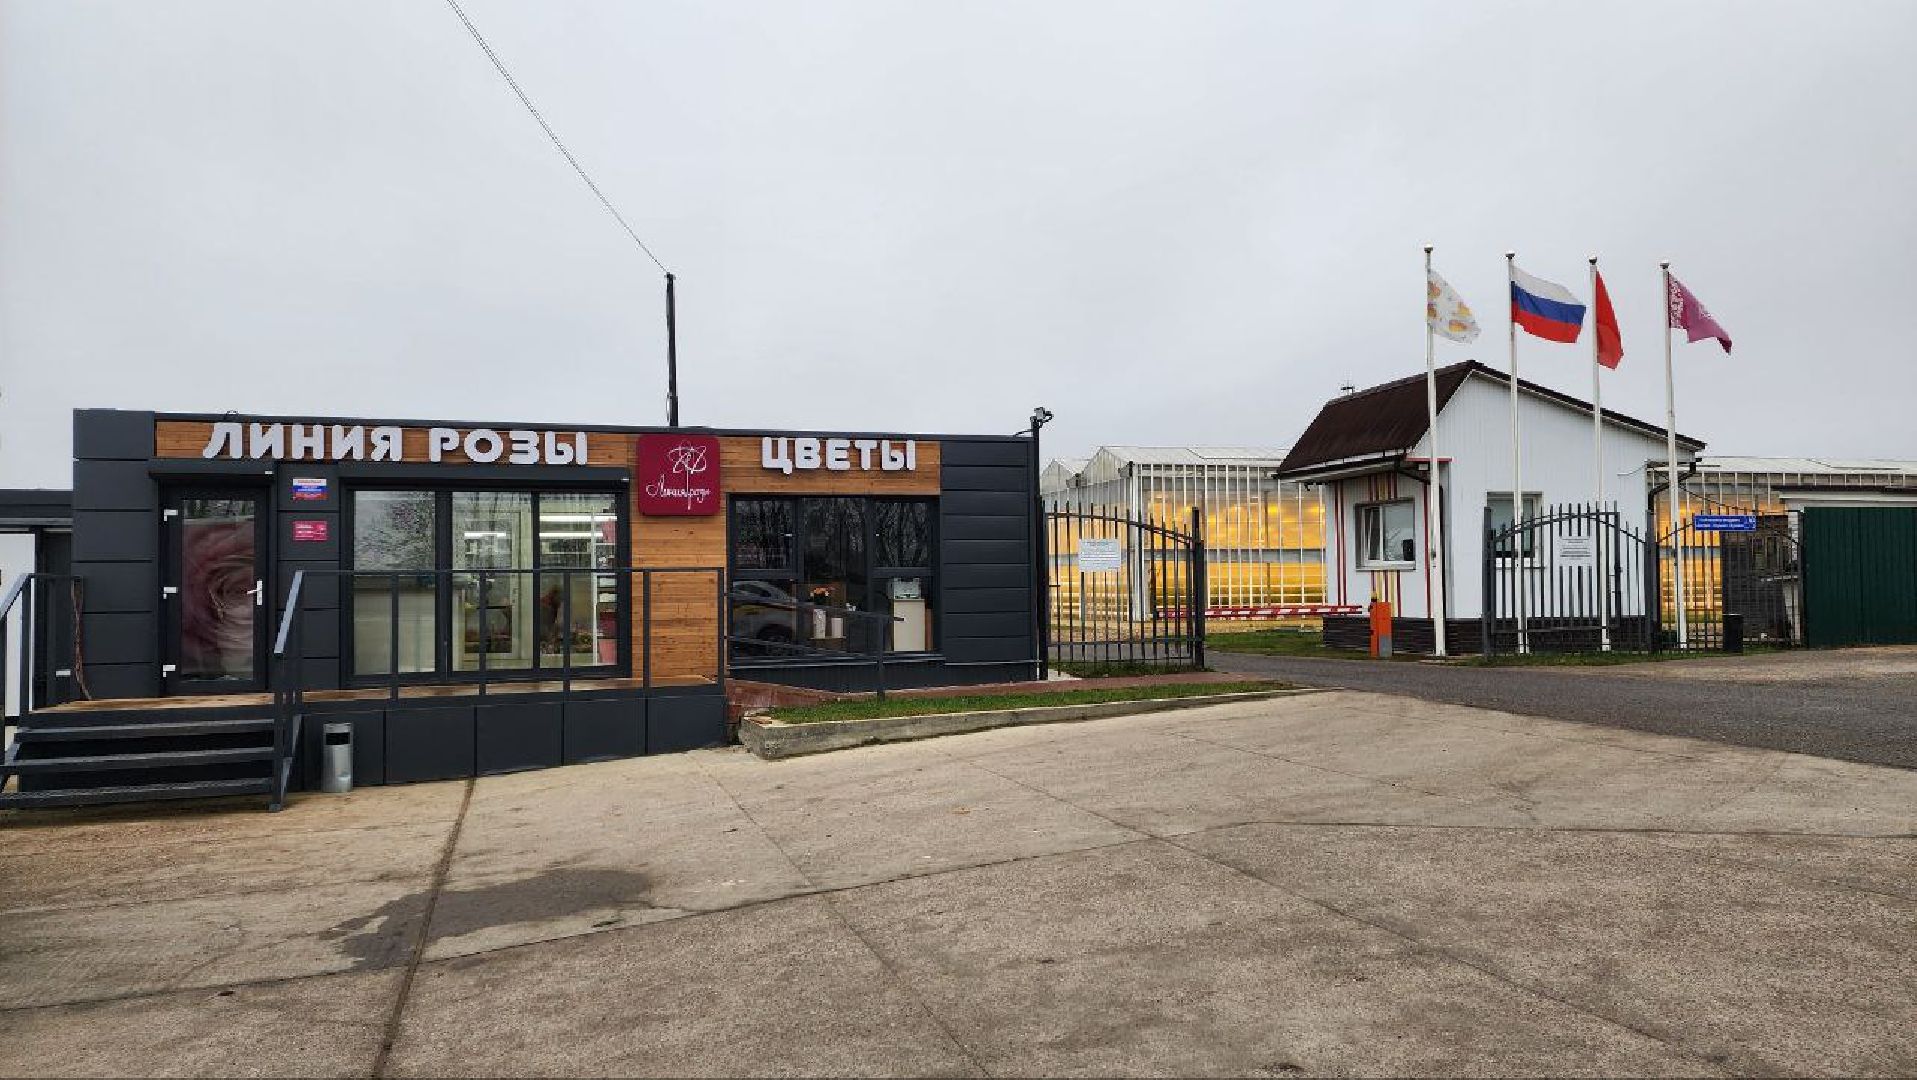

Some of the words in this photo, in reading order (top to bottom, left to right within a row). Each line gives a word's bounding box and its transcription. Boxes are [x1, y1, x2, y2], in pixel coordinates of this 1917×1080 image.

[203, 422, 402, 461] ЛИНИЯ
[429, 427, 588, 465] РОЗЫ
[762, 437, 916, 474] ЦВЕТЫ
